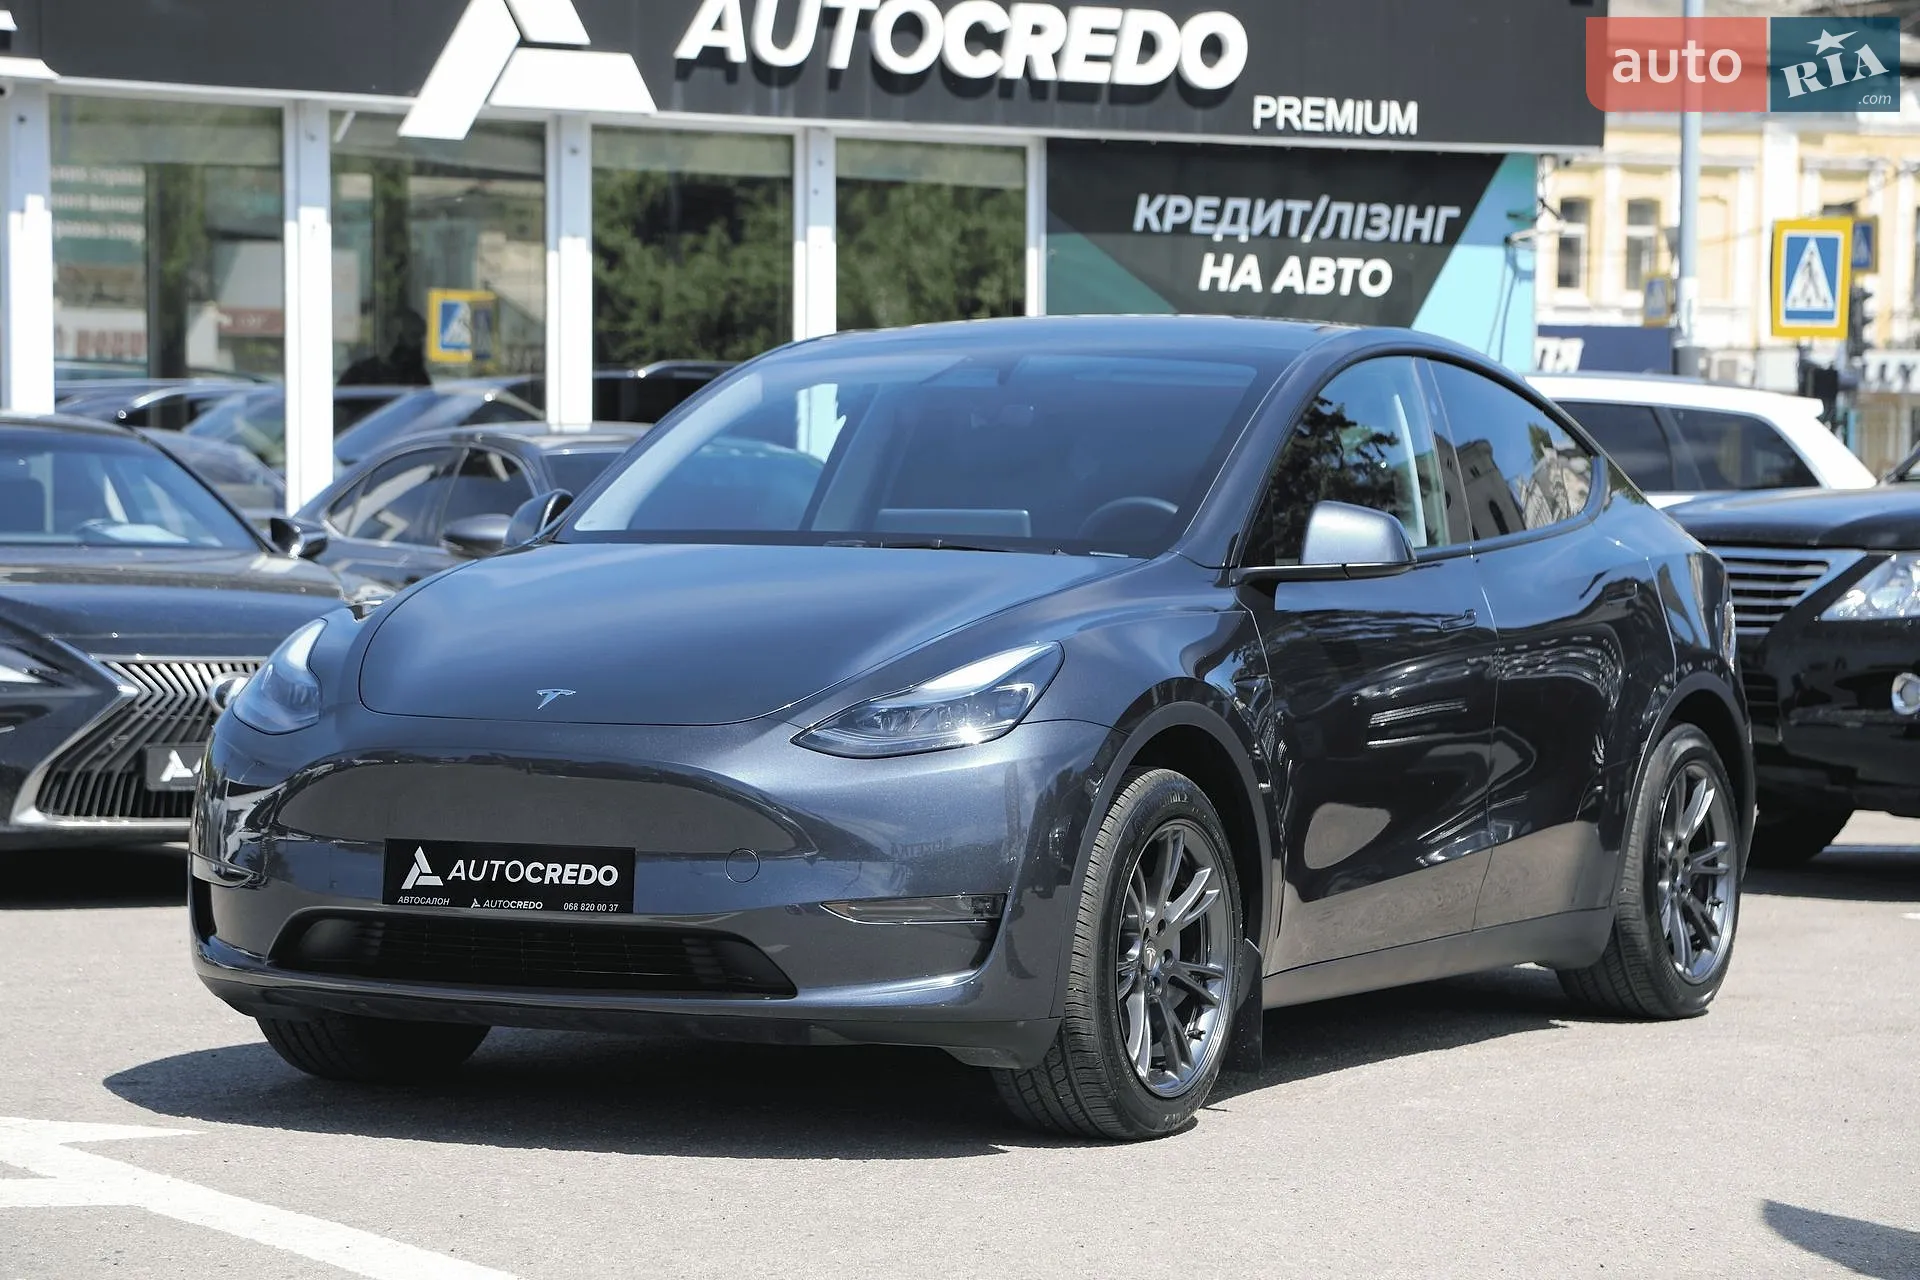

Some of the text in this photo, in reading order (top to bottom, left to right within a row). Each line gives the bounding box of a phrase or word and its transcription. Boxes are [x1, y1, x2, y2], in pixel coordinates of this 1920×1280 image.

[673, 0, 1248, 89] AUTOCREDO
[1252, 95, 1418, 135] PREMIUM
[1133, 193, 1461, 243] КРЕДИТ/ЛІЗІНГ
[1199, 252, 1393, 298] НА АВТО
[447, 859, 619, 887] AUTOCREDO
[397, 895, 450, 906] АВТОСАЛОН
[483, 899, 543, 910] AUTOCREDO
[563, 902, 619, 912] 068 820 00 37
